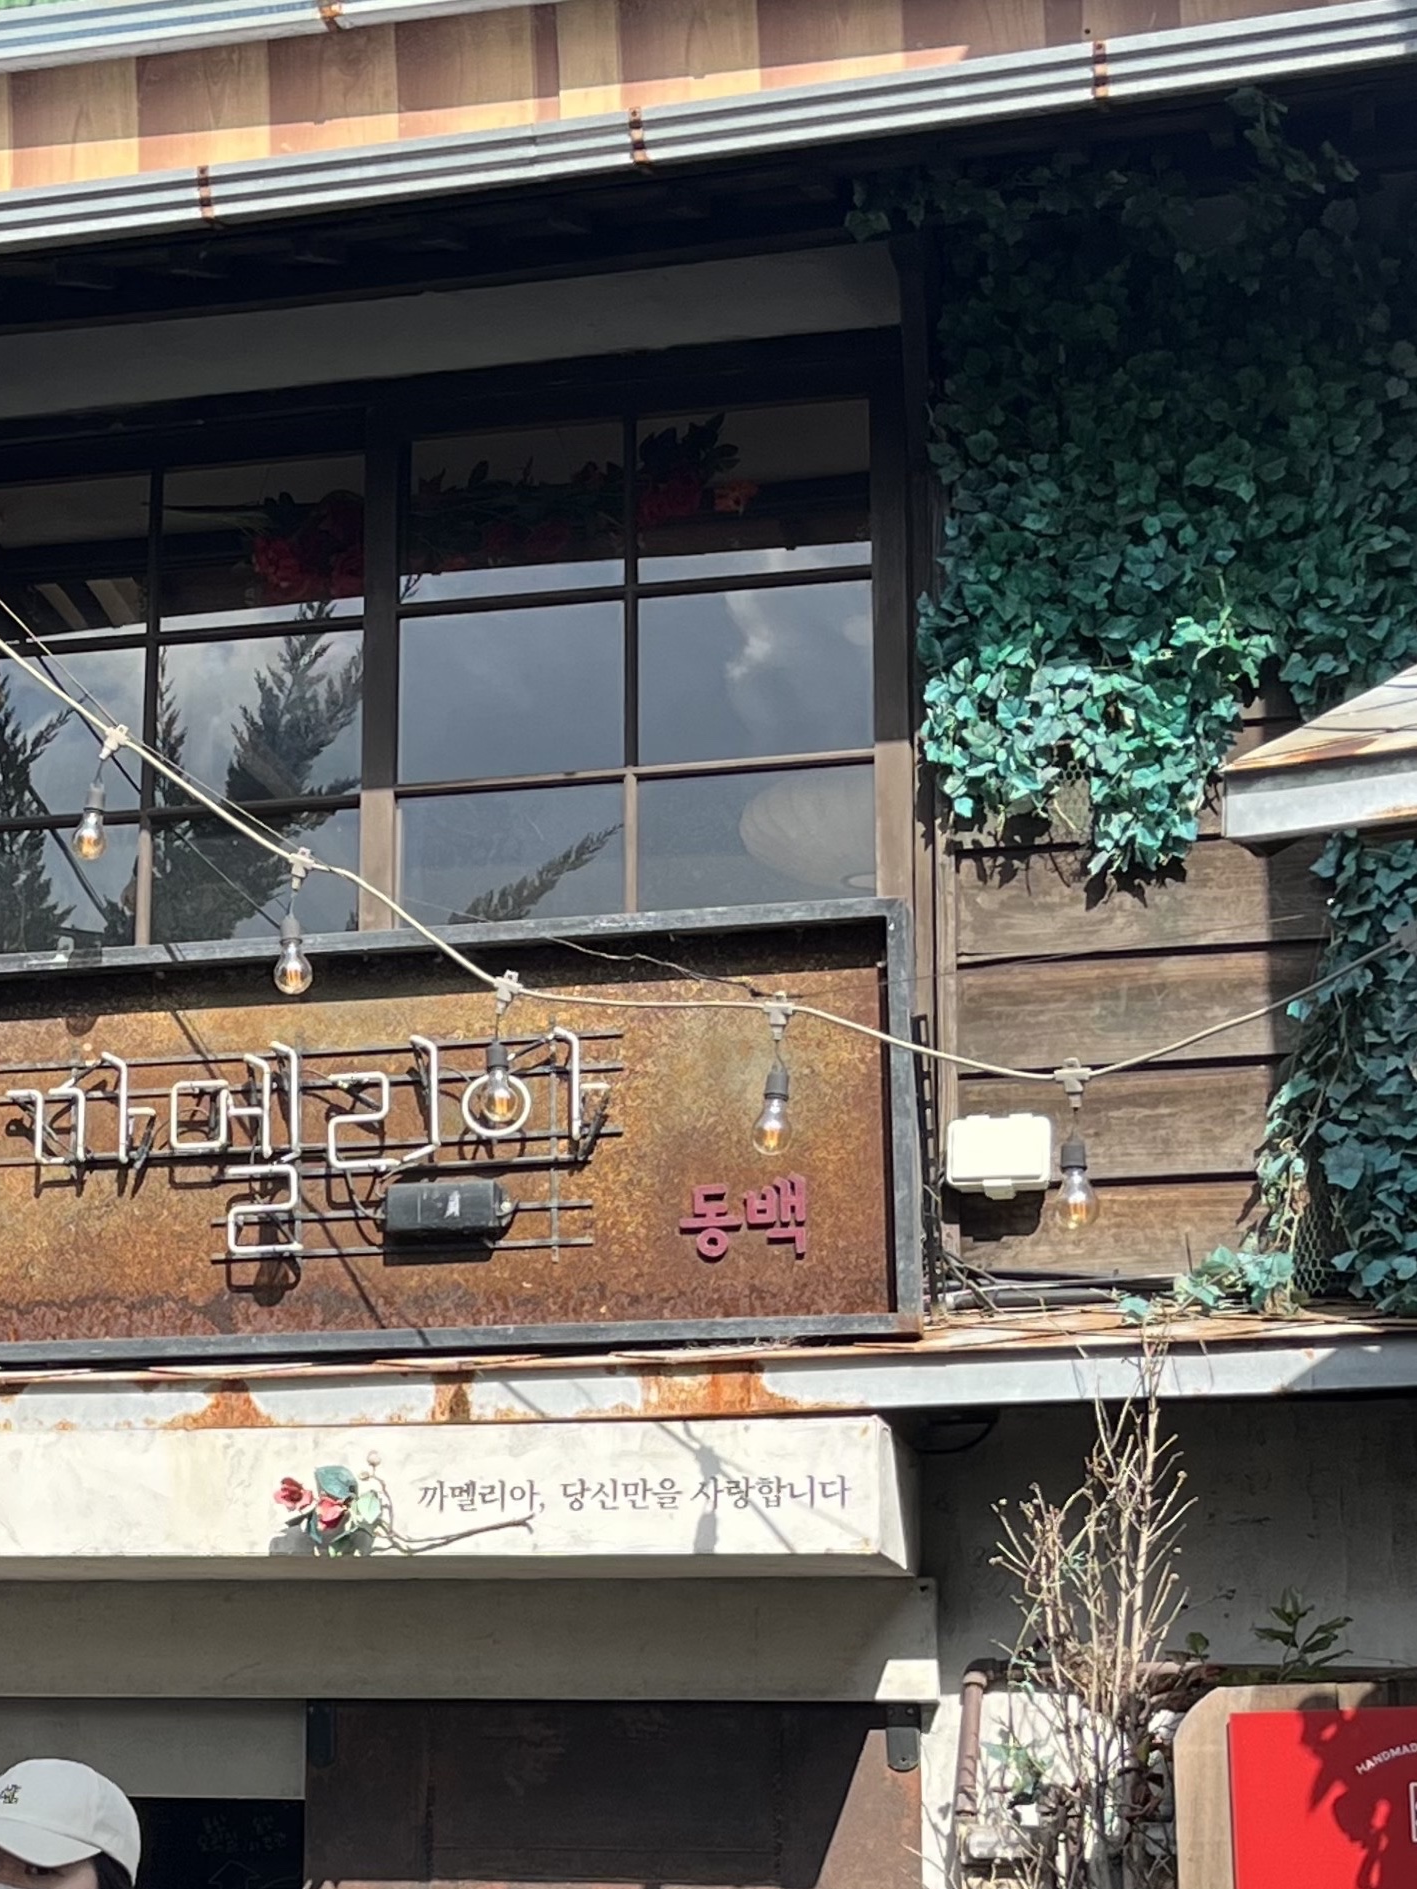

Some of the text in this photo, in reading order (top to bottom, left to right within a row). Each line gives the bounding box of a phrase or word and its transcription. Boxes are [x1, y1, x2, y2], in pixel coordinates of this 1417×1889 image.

[5, 1026, 611, 1256] 까멜리아
[679, 1173, 808, 1258] 동백
[416, 1473, 852, 1514] 까멜리아, 당신만을 사랑합니다
